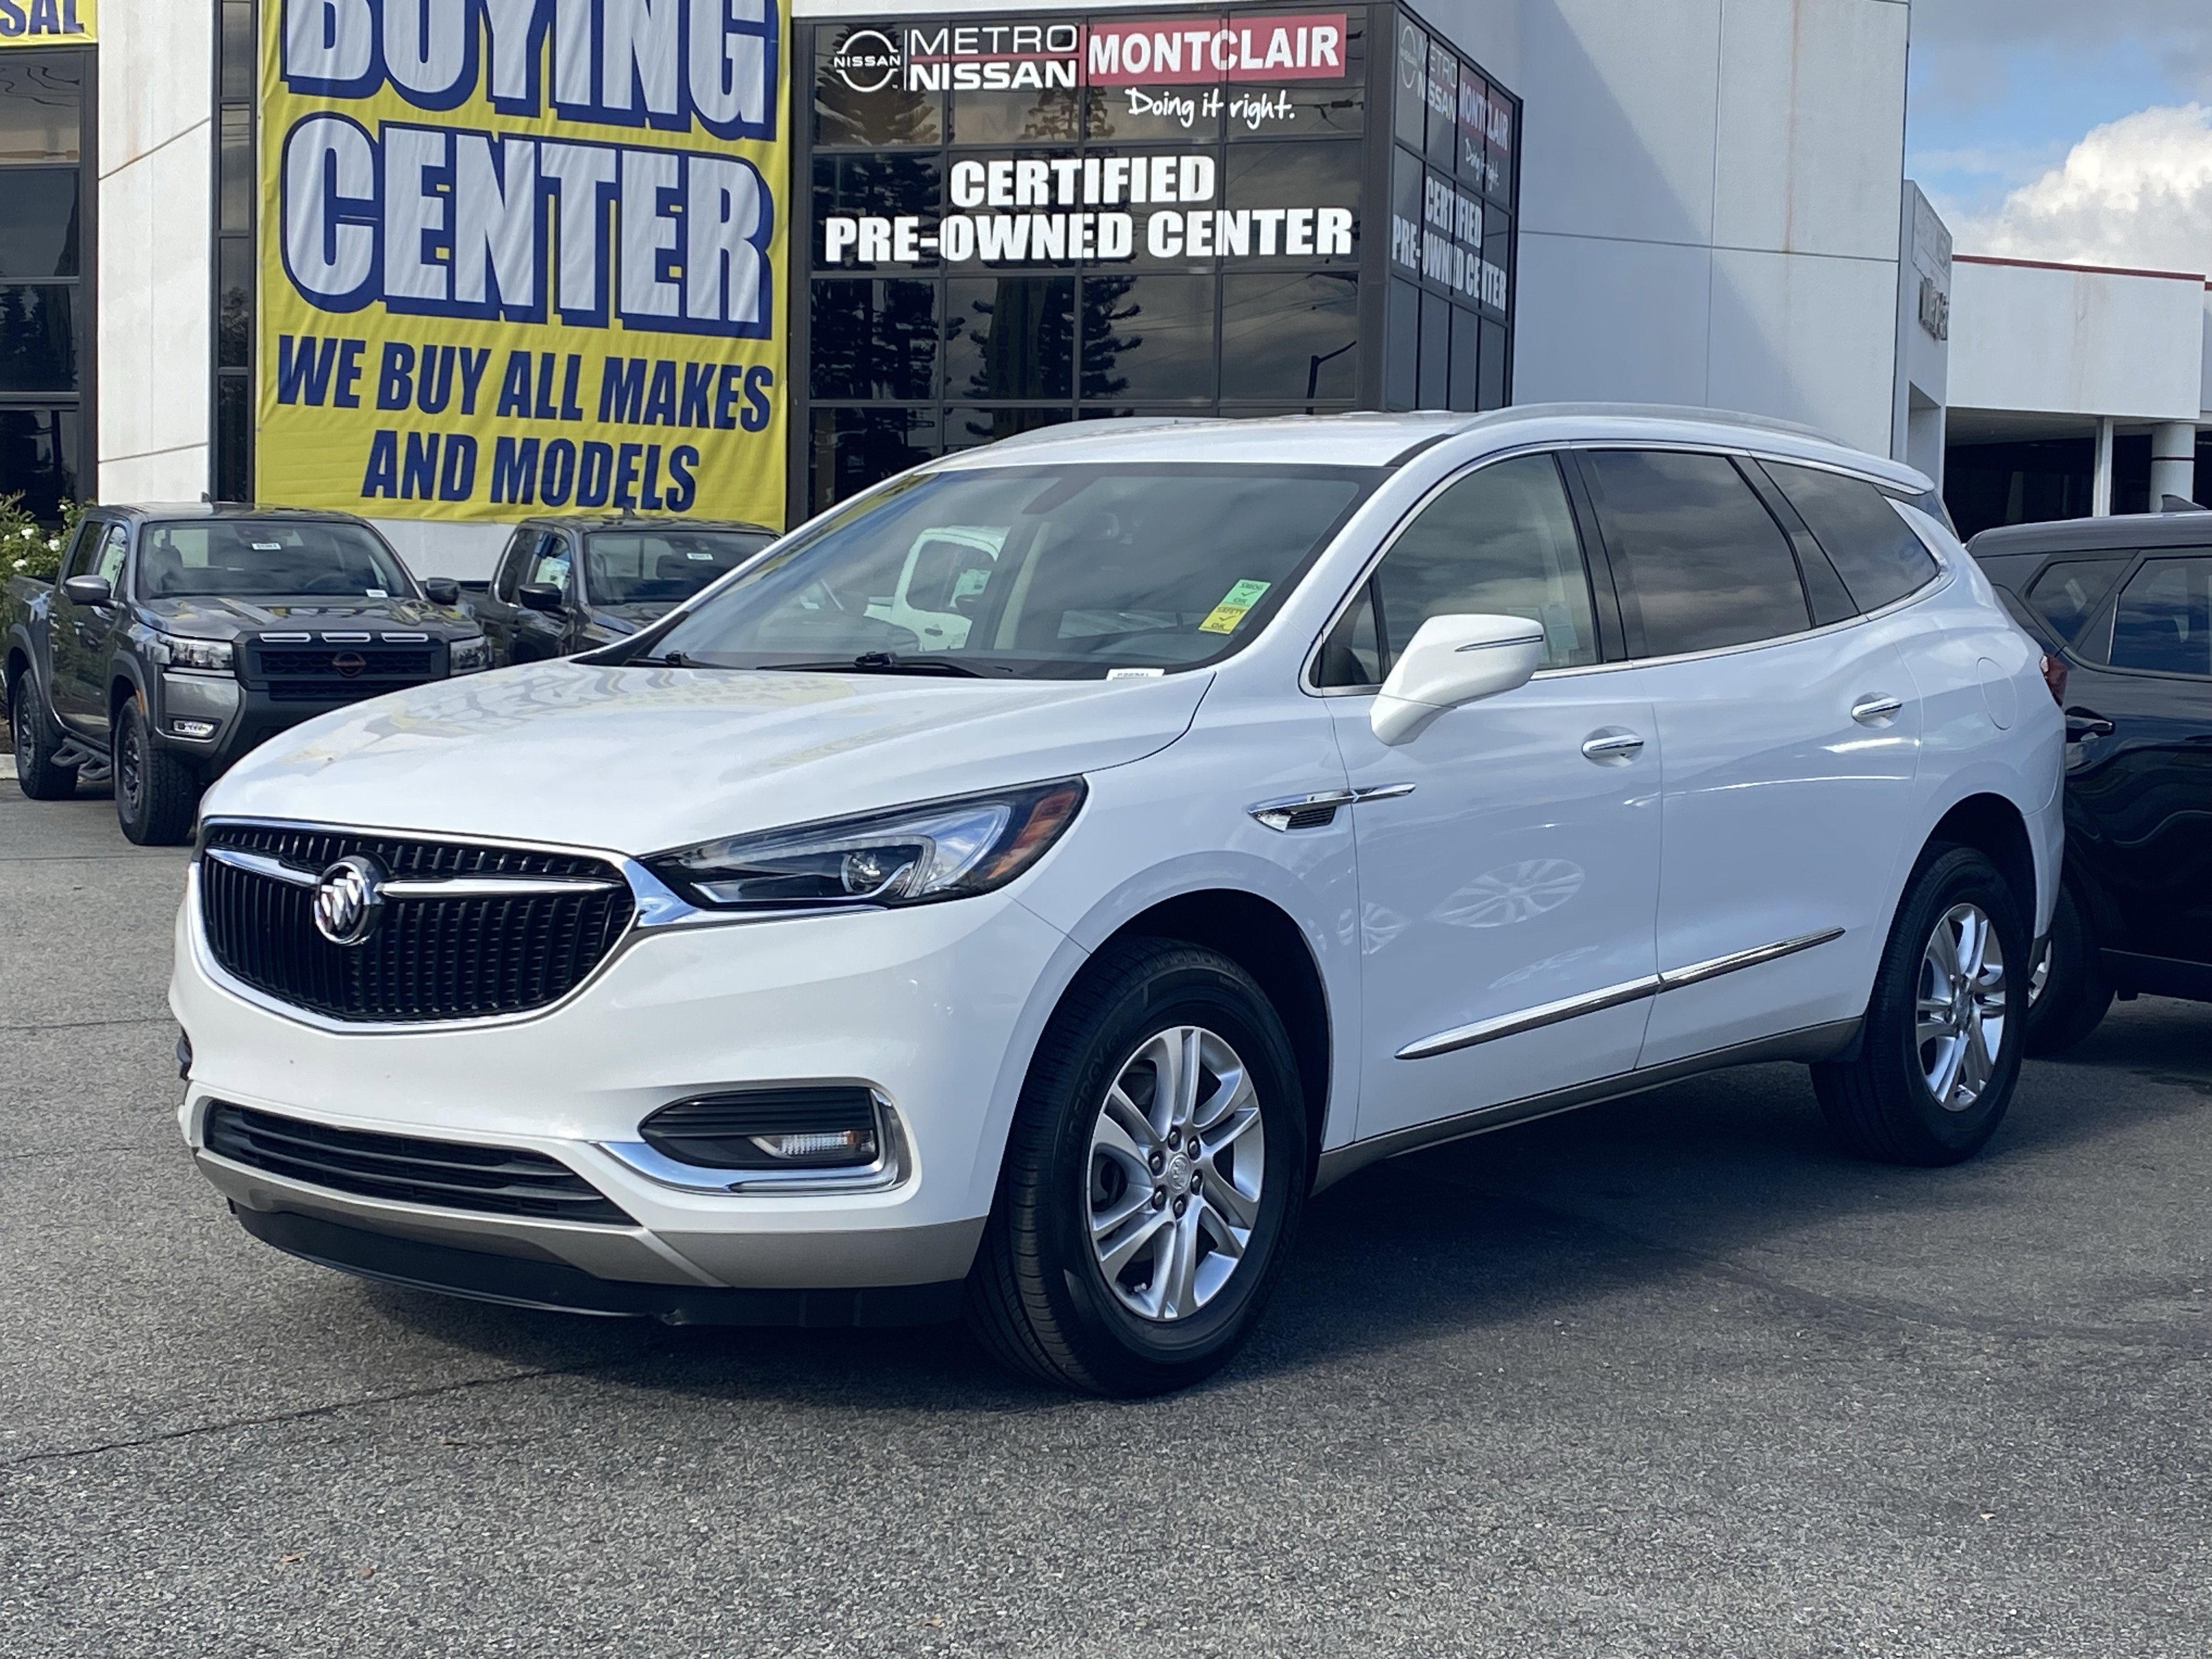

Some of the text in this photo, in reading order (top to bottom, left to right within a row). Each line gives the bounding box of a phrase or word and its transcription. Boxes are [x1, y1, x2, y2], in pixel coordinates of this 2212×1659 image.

[833, 54, 901, 68] NISSAN
[911, 24, 1077, 55] METRO
[1088, 27, 1340, 75] MONTCLAIR
[910, 60, 1076, 92] NISSAN
[1124, 87, 1295, 129] Doing it right.
[950, 155, 1215, 208] CERTIFIED
[280, 111, 774, 340] CENTER
[825, 207, 1353, 262] PRE-OWNED CENTER
[1425, 175, 1482, 249] CERTIFIED
[277, 335, 772, 432] WE BUY ALL MAKES
[360, 430, 699, 512] AND MODELS
